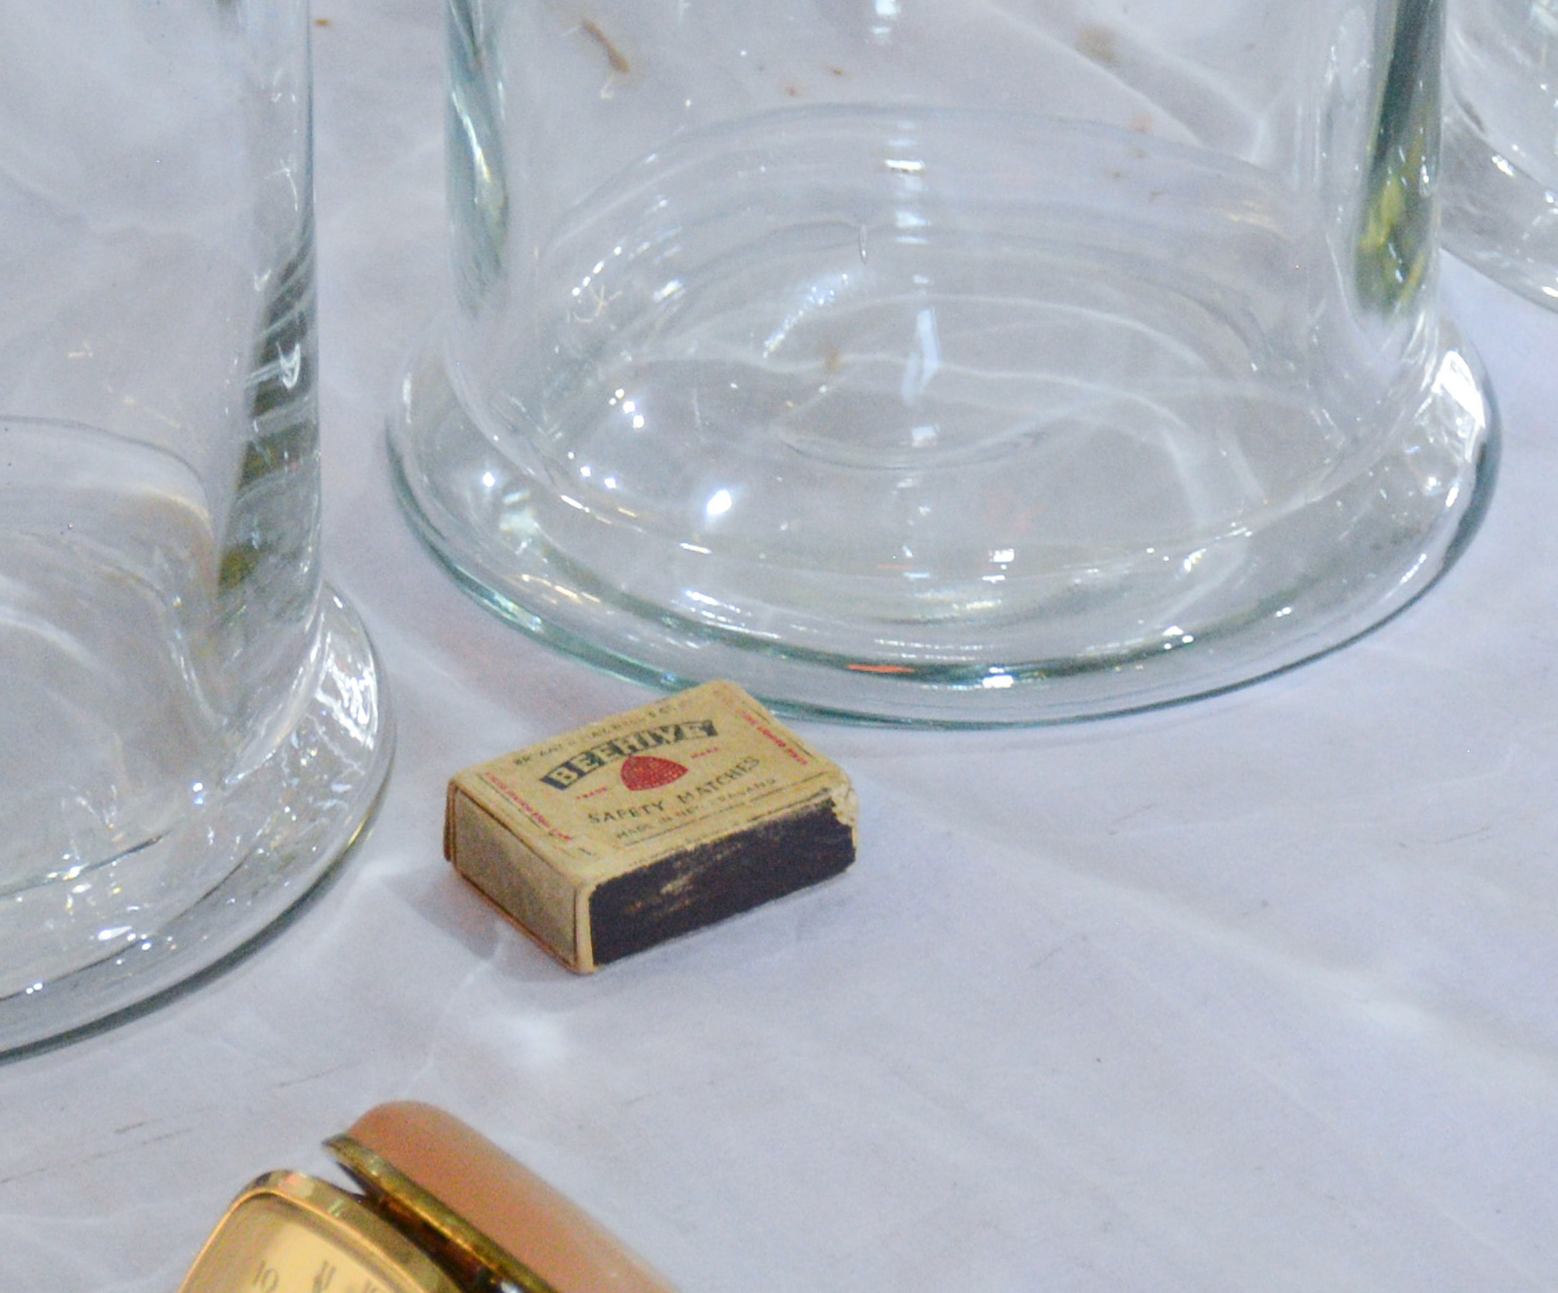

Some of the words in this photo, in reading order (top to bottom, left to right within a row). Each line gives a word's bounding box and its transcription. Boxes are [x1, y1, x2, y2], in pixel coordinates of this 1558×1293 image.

[542, 720, 716, 789] BEEHIVE
[587, 799, 666, 824] SAFETY
[676, 755, 761, 805] MATCHES
